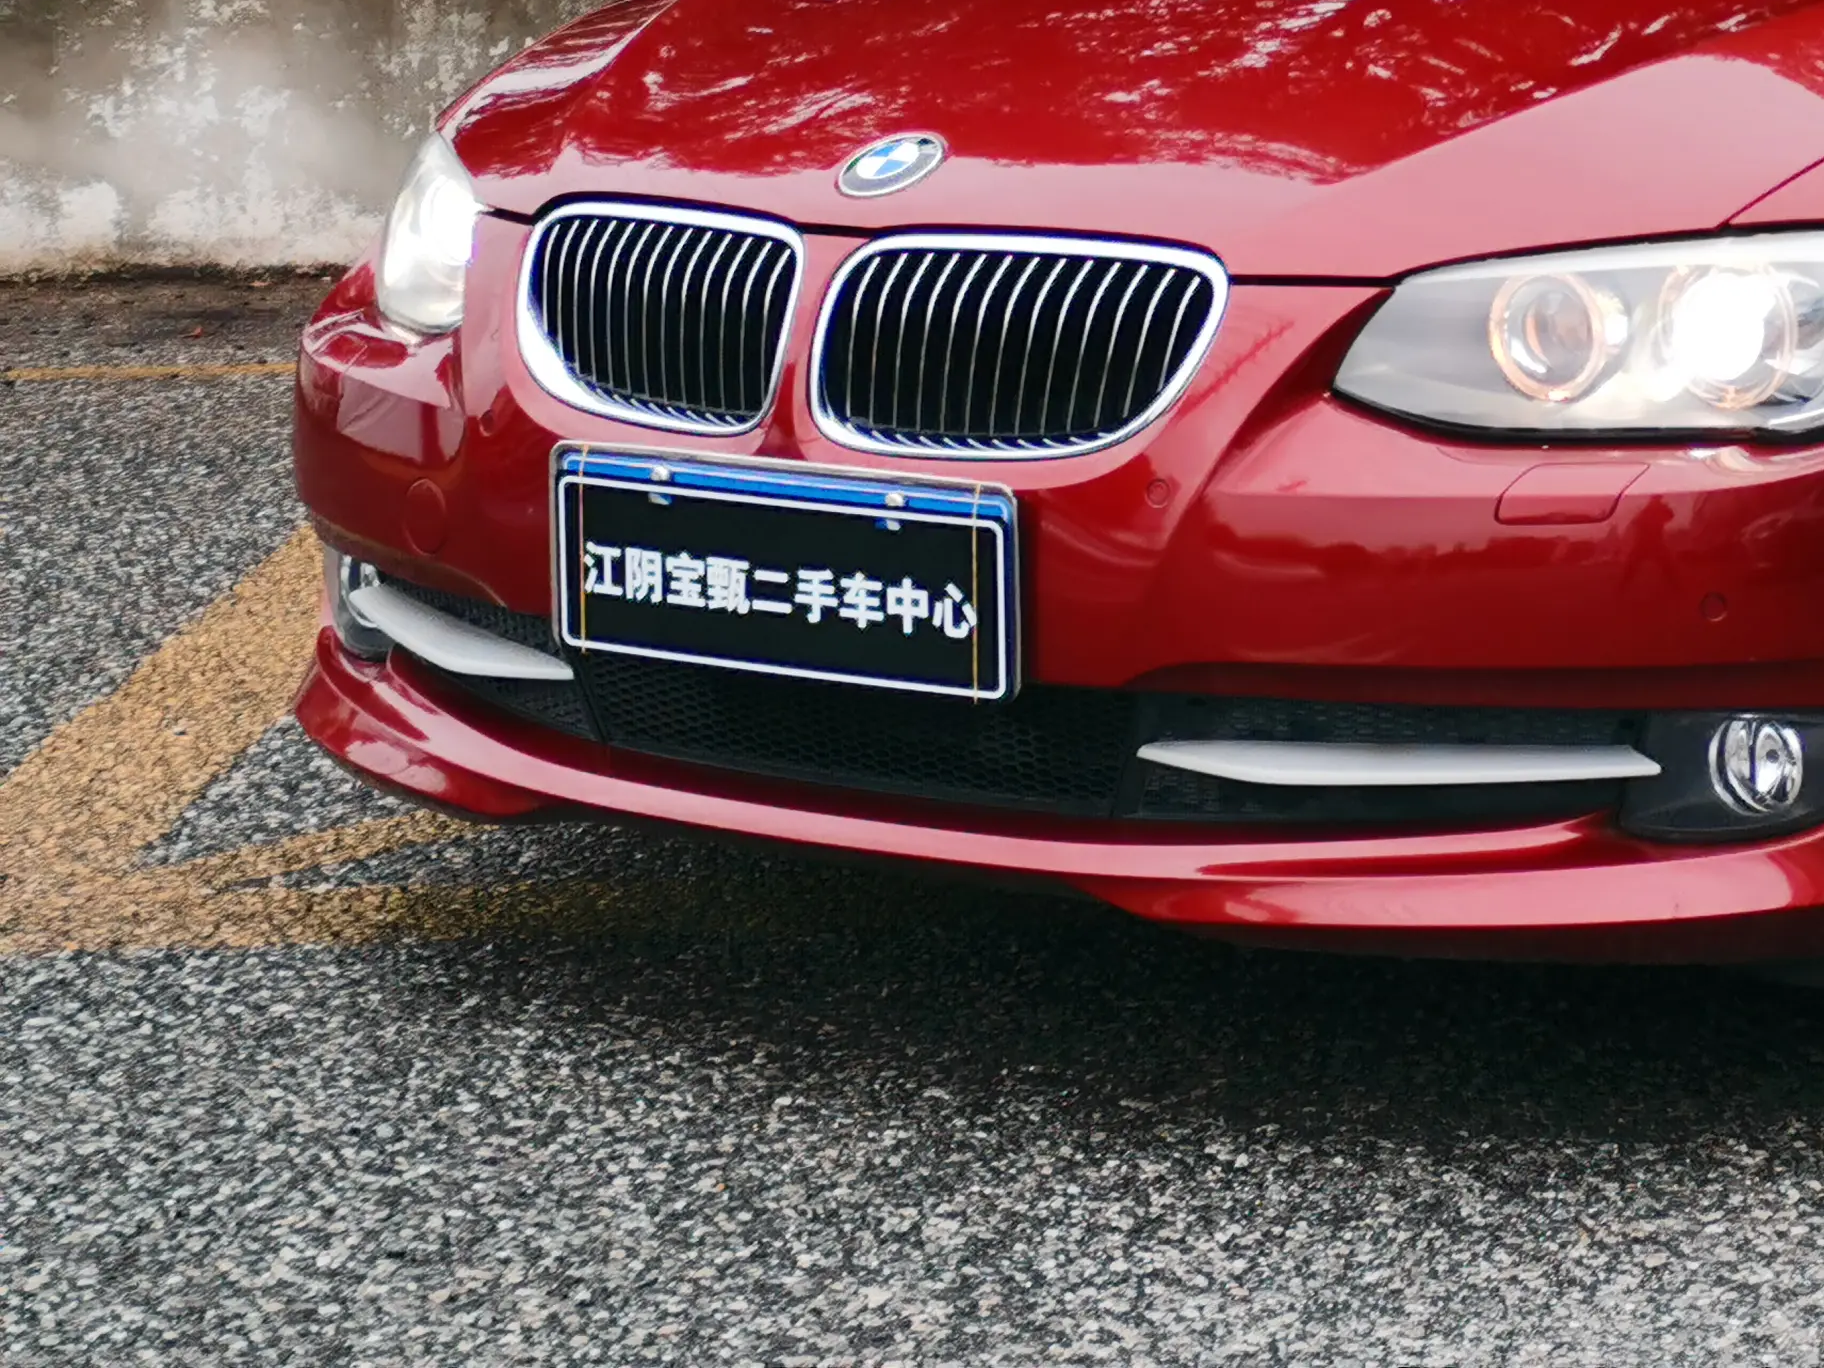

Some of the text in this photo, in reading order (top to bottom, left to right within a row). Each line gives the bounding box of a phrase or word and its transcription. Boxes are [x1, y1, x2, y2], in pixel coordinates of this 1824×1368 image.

[582, 540, 978, 639] 江阴宝甄二手车中心
